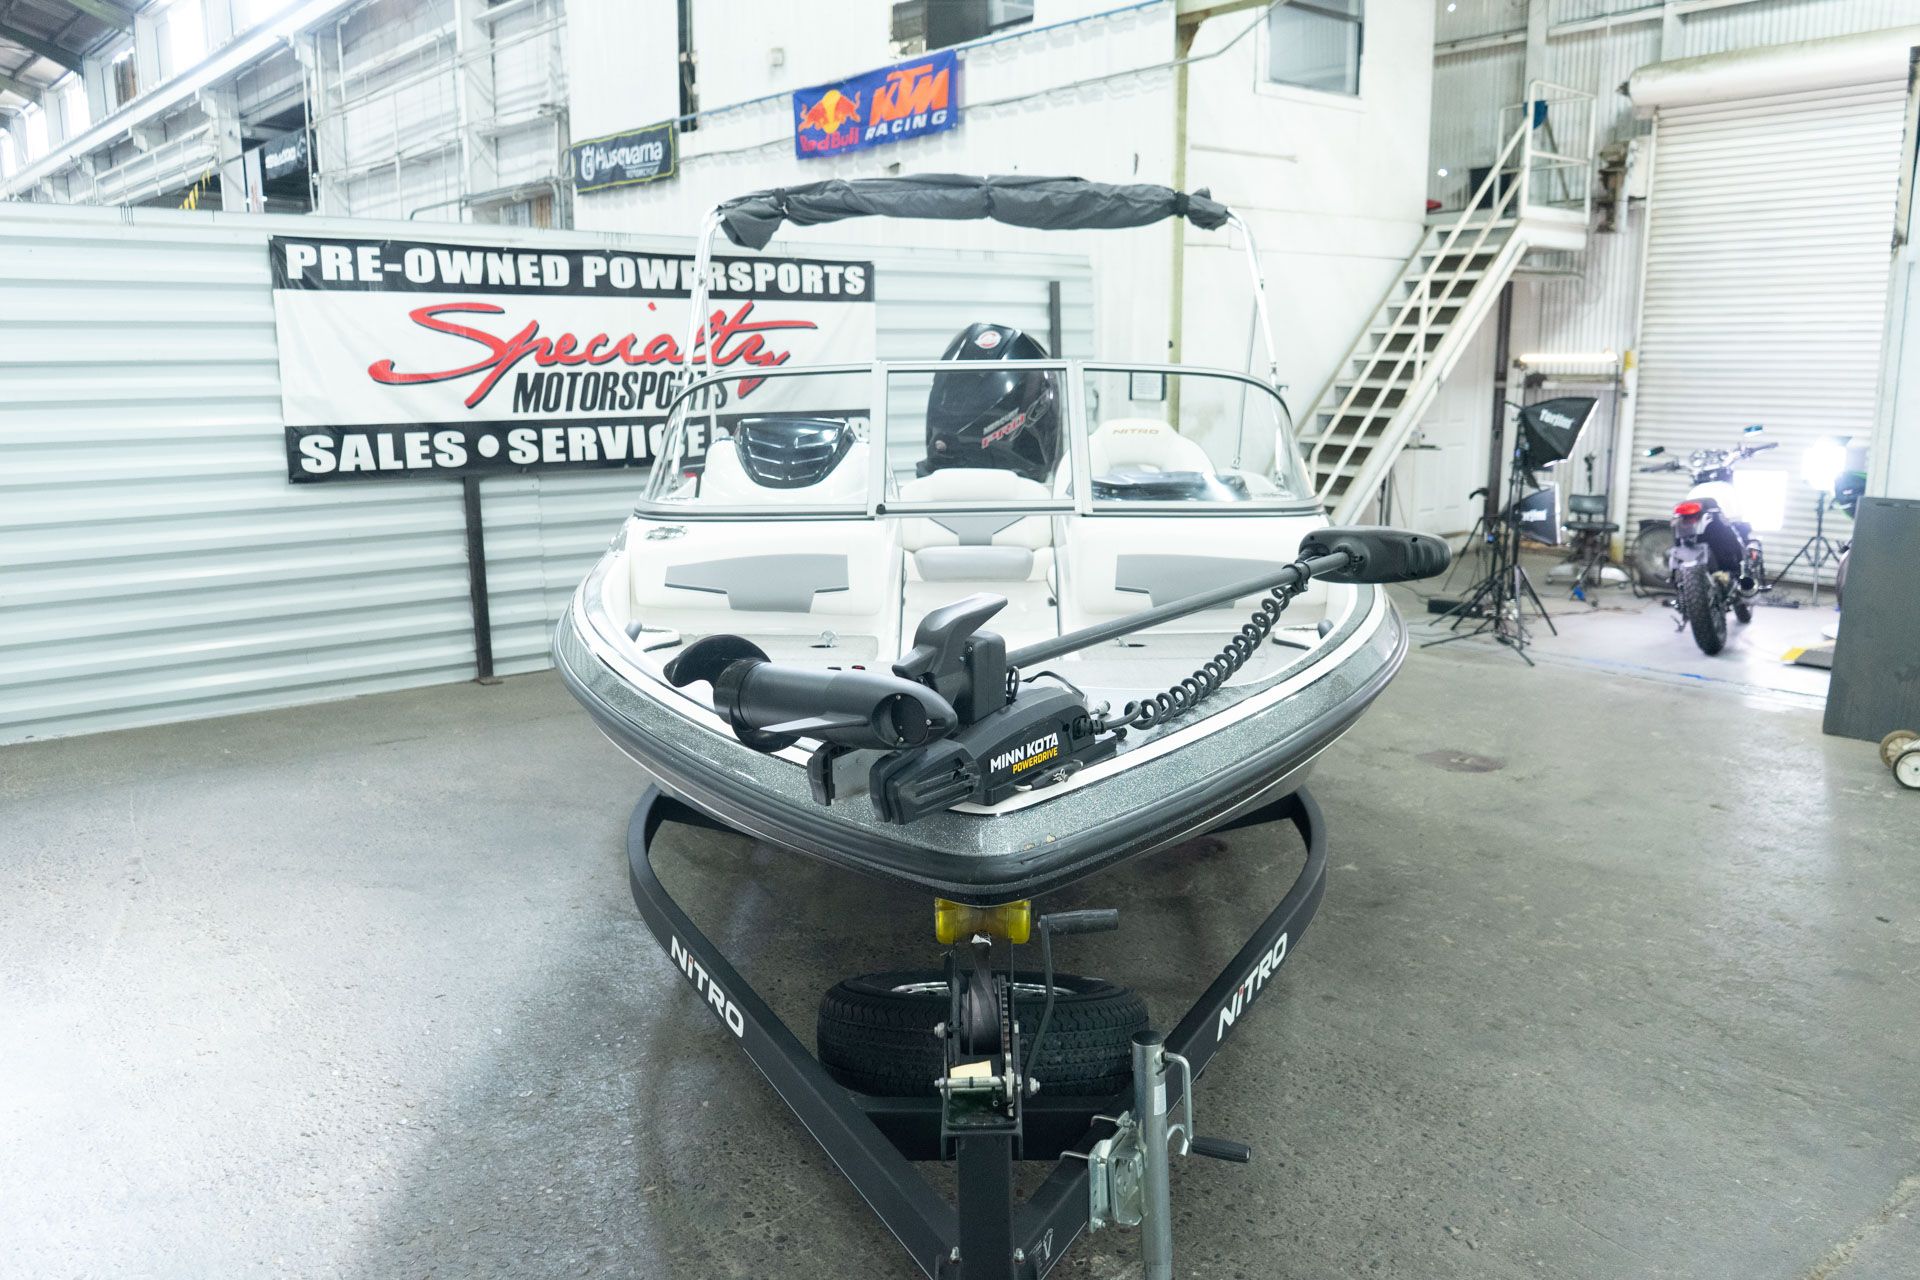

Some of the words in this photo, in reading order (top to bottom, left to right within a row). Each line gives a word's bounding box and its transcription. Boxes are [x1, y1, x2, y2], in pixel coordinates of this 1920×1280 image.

[869, 63, 949, 126] KTM
[800, 134, 831, 152] Red
[831, 127, 859, 149] Bull
[864, 109, 948, 141] RACING
[285, 243, 570, 287] PRE-OWNED
[582, 255, 866, 294] POWERSPORTS
[368, 300, 818, 409] Specialty
[299, 430, 468, 474] SALES
[990, 746, 1025, 774] MINN
[1026, 732, 1059, 757] KOTA
[1012, 746, 1058, 774] POWERDRIVE
